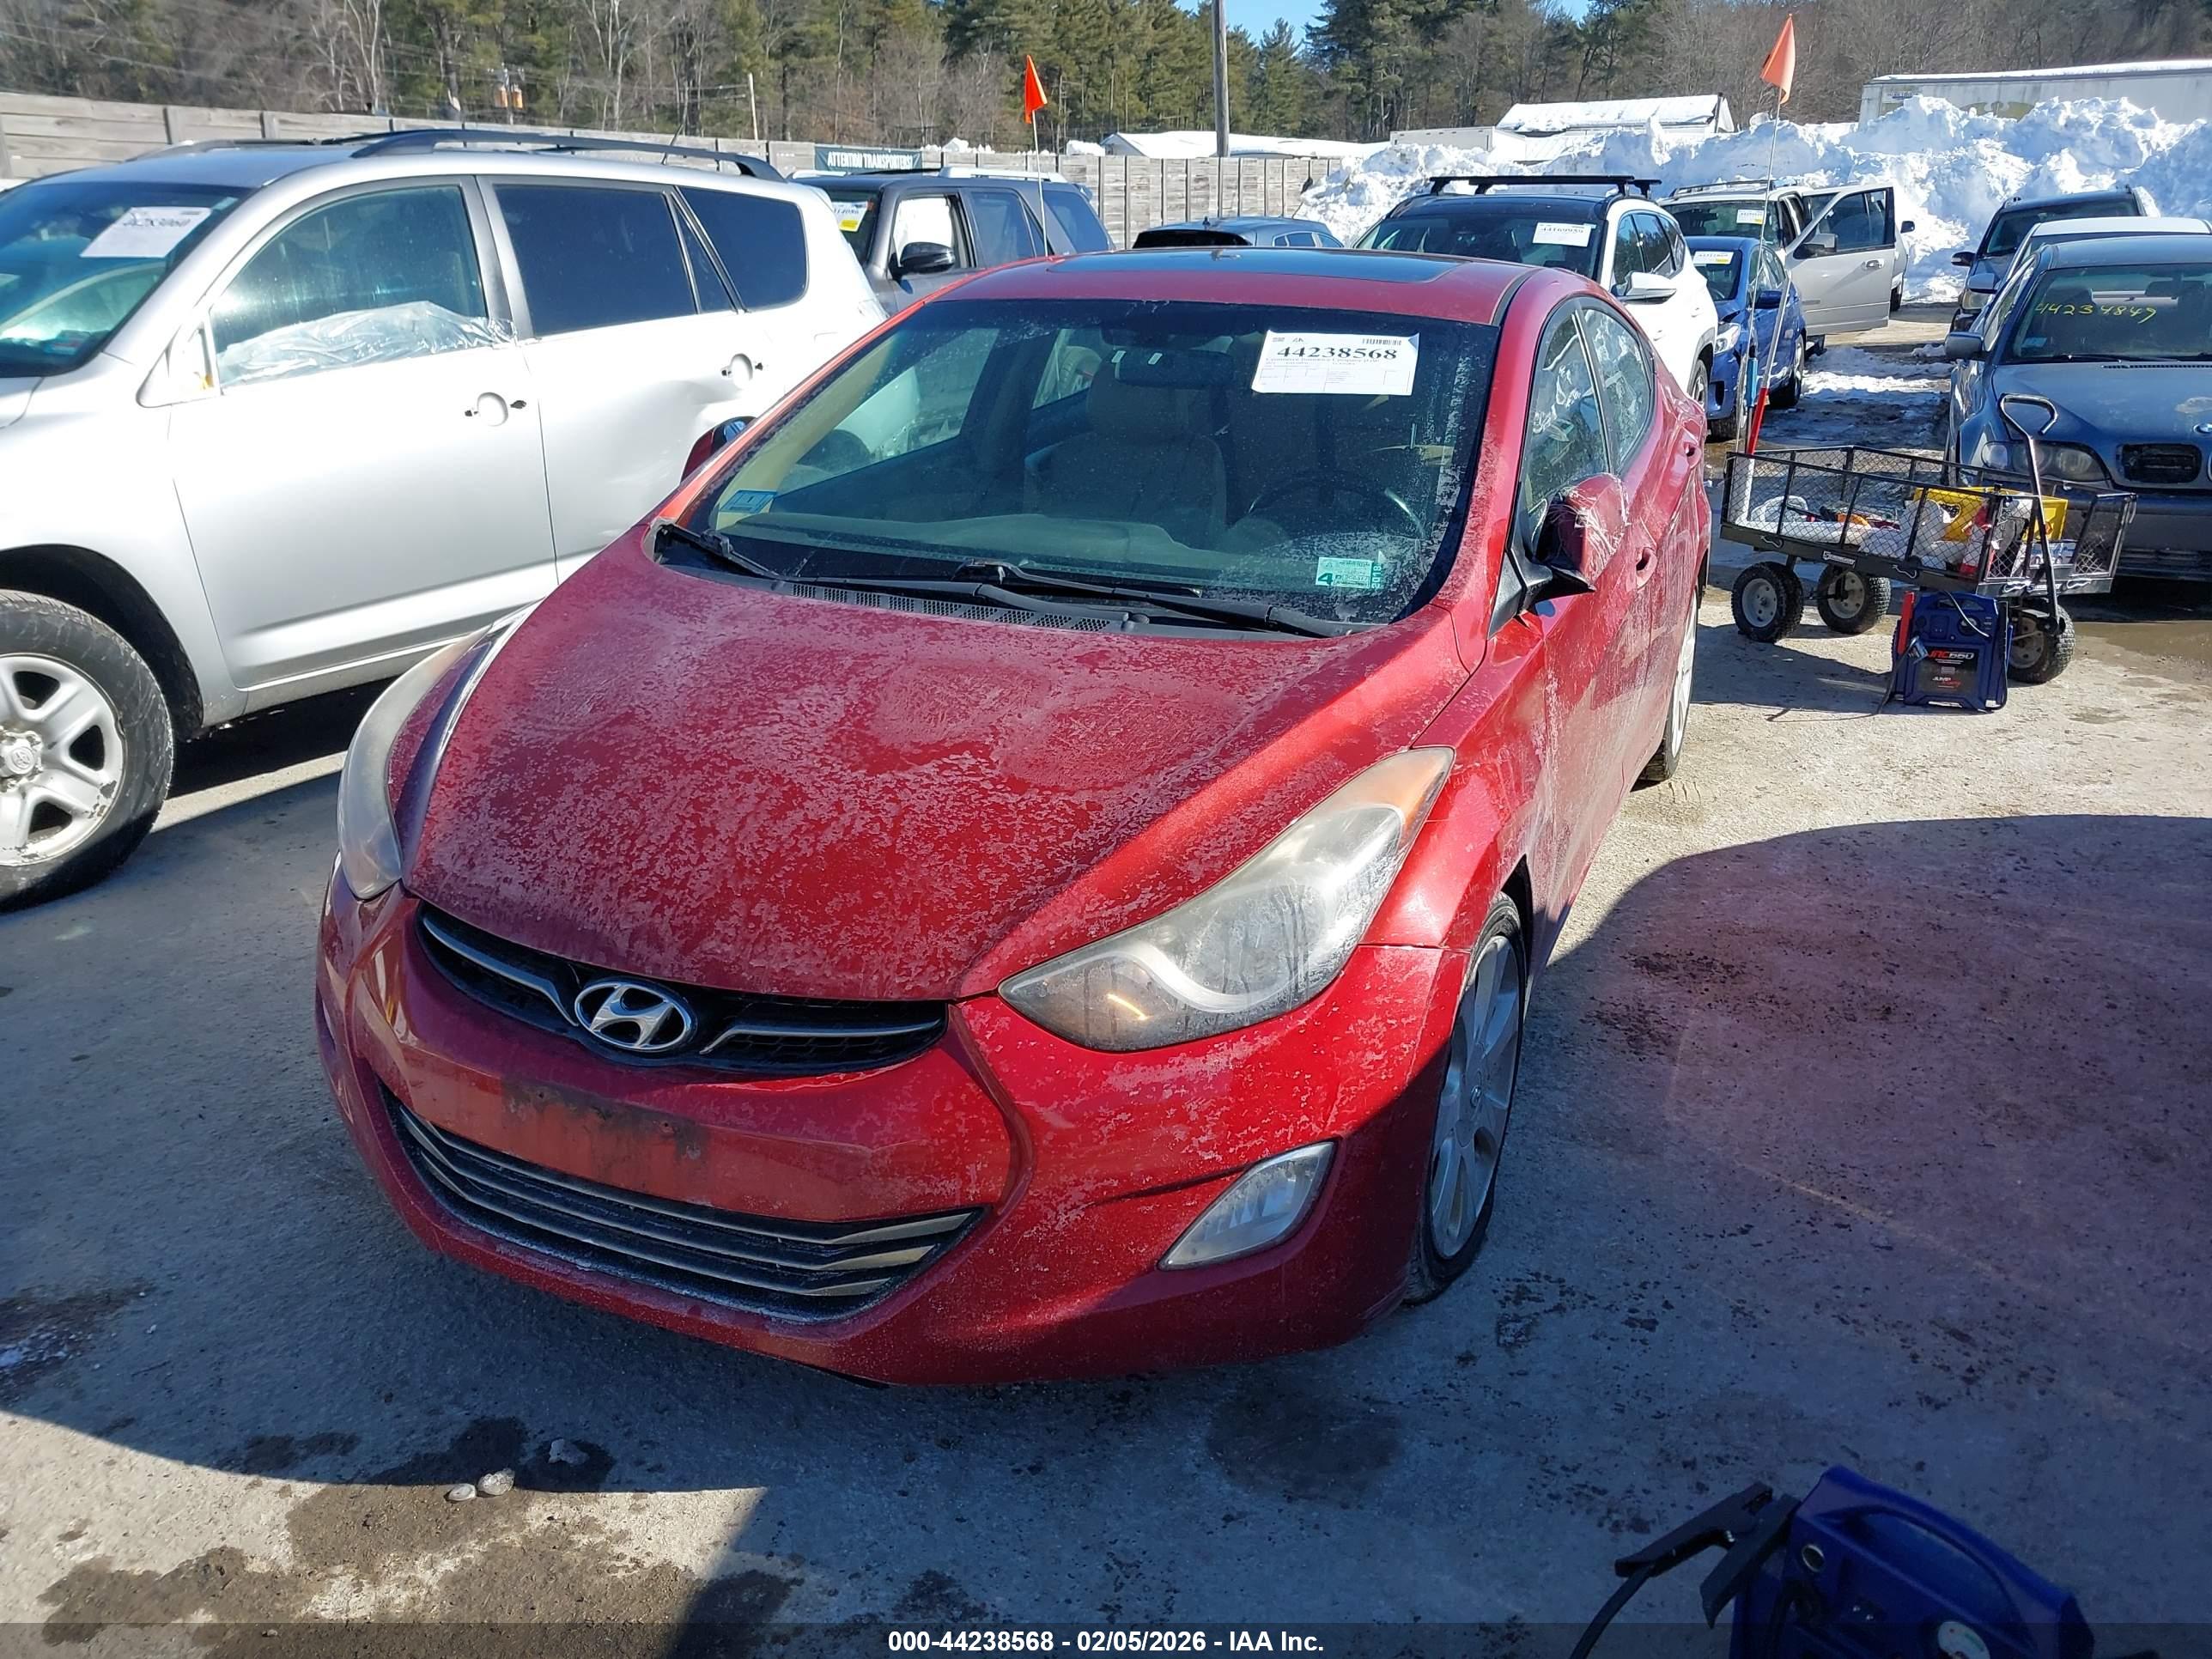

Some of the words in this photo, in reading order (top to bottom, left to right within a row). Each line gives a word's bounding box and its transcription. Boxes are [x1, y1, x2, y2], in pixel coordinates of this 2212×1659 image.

[827, 151, 863, 167] ATTENTION
[2035, 302, 2157, 324] 44234849
[1277, 346, 1398, 360] 44238568
[1317, 572, 1334, 585] 4
